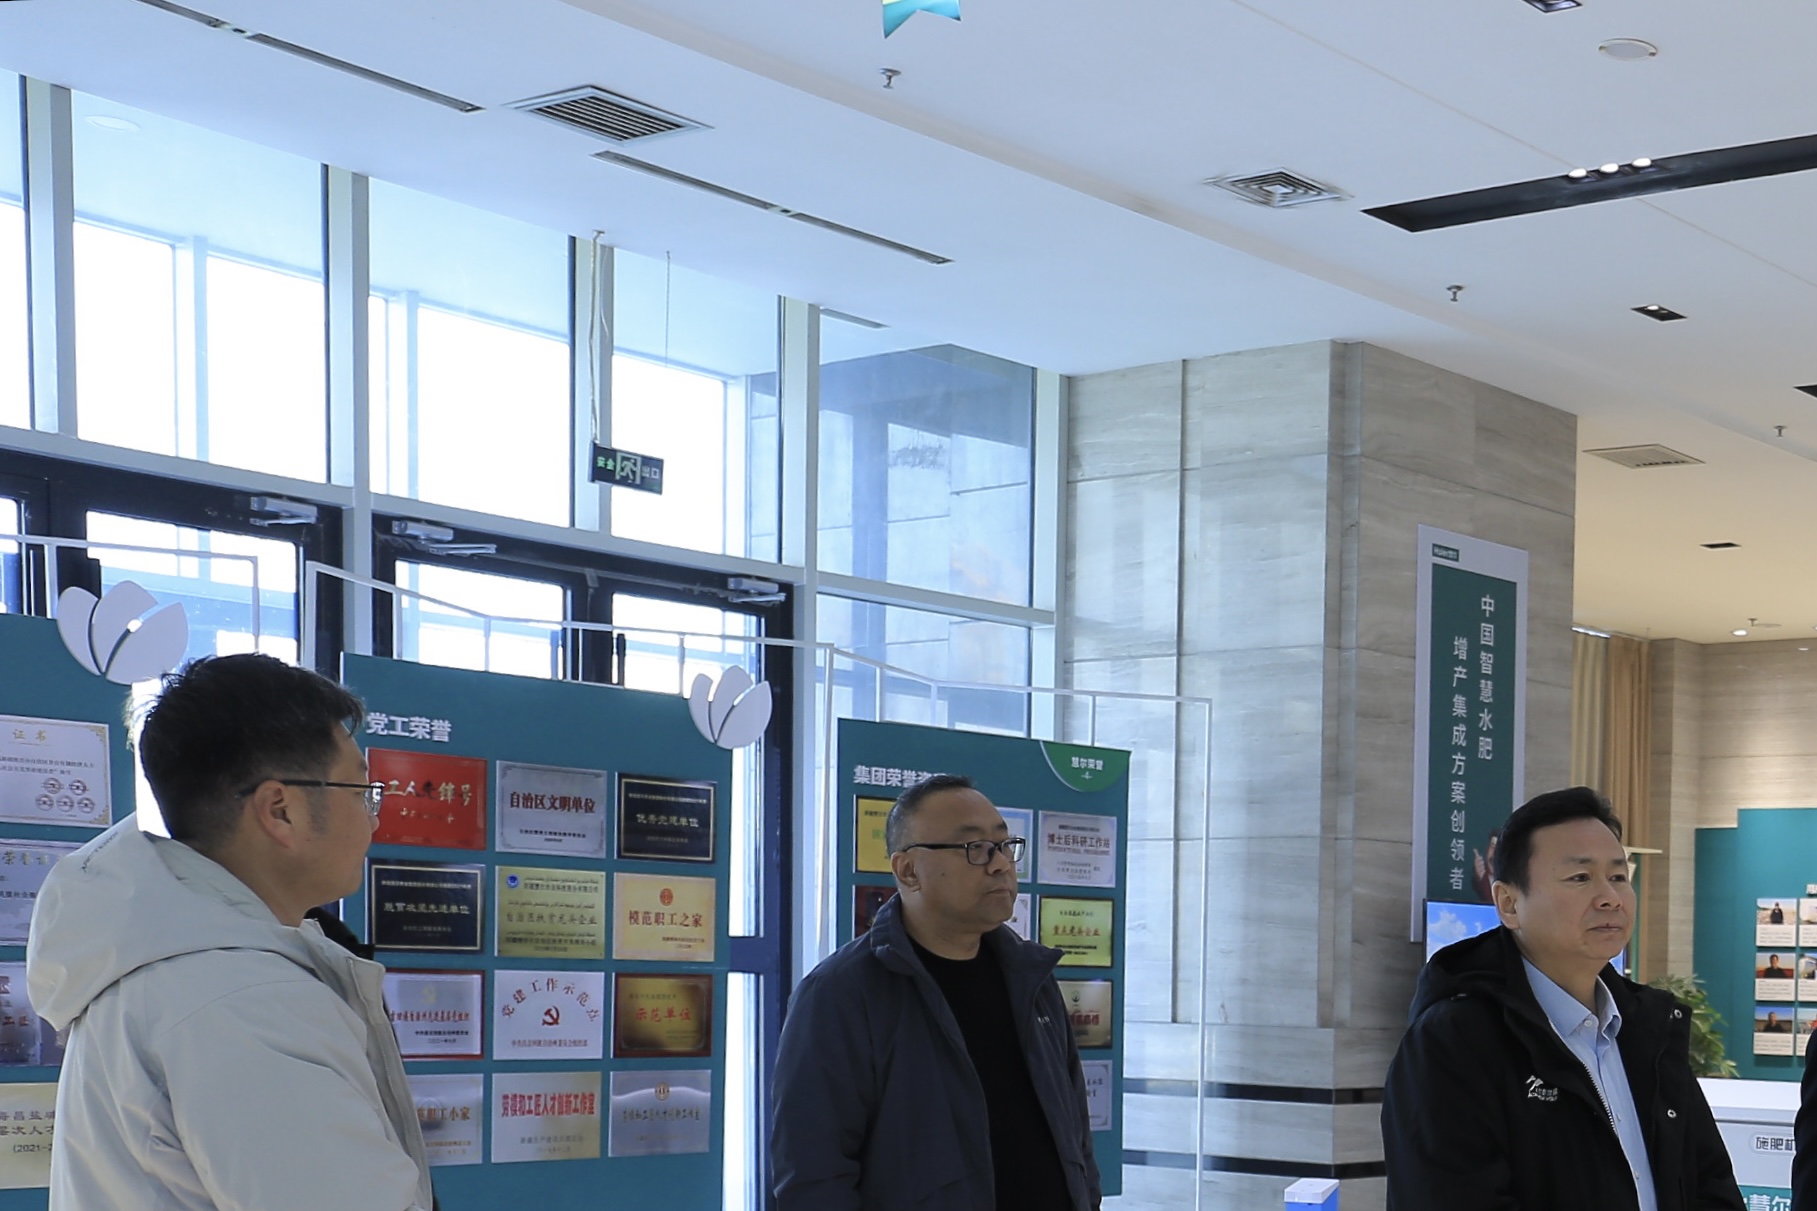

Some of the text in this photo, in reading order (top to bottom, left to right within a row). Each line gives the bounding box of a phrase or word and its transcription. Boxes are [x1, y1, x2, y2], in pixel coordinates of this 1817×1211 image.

[1477, 594, 1495, 761] 中国智慧水肥
[366, 711, 452, 743] 党工荣誉
[1071, 756, 1104, 771] 慧尔荣誉
[1449, 635, 1468, 891] 增产集成方案创领者
[509, 791, 597, 815] 自治区文明单位
[1047, 832, 1110, 849] 博士后科研工作站
[629, 910, 703, 928] 模范职工之家
[502, 977, 599, 1022] 党建工作示范点
[635, 1007, 693, 1023] 示范单位
[501, 1092, 596, 1118] 劳模和工匠人才创新工作室
